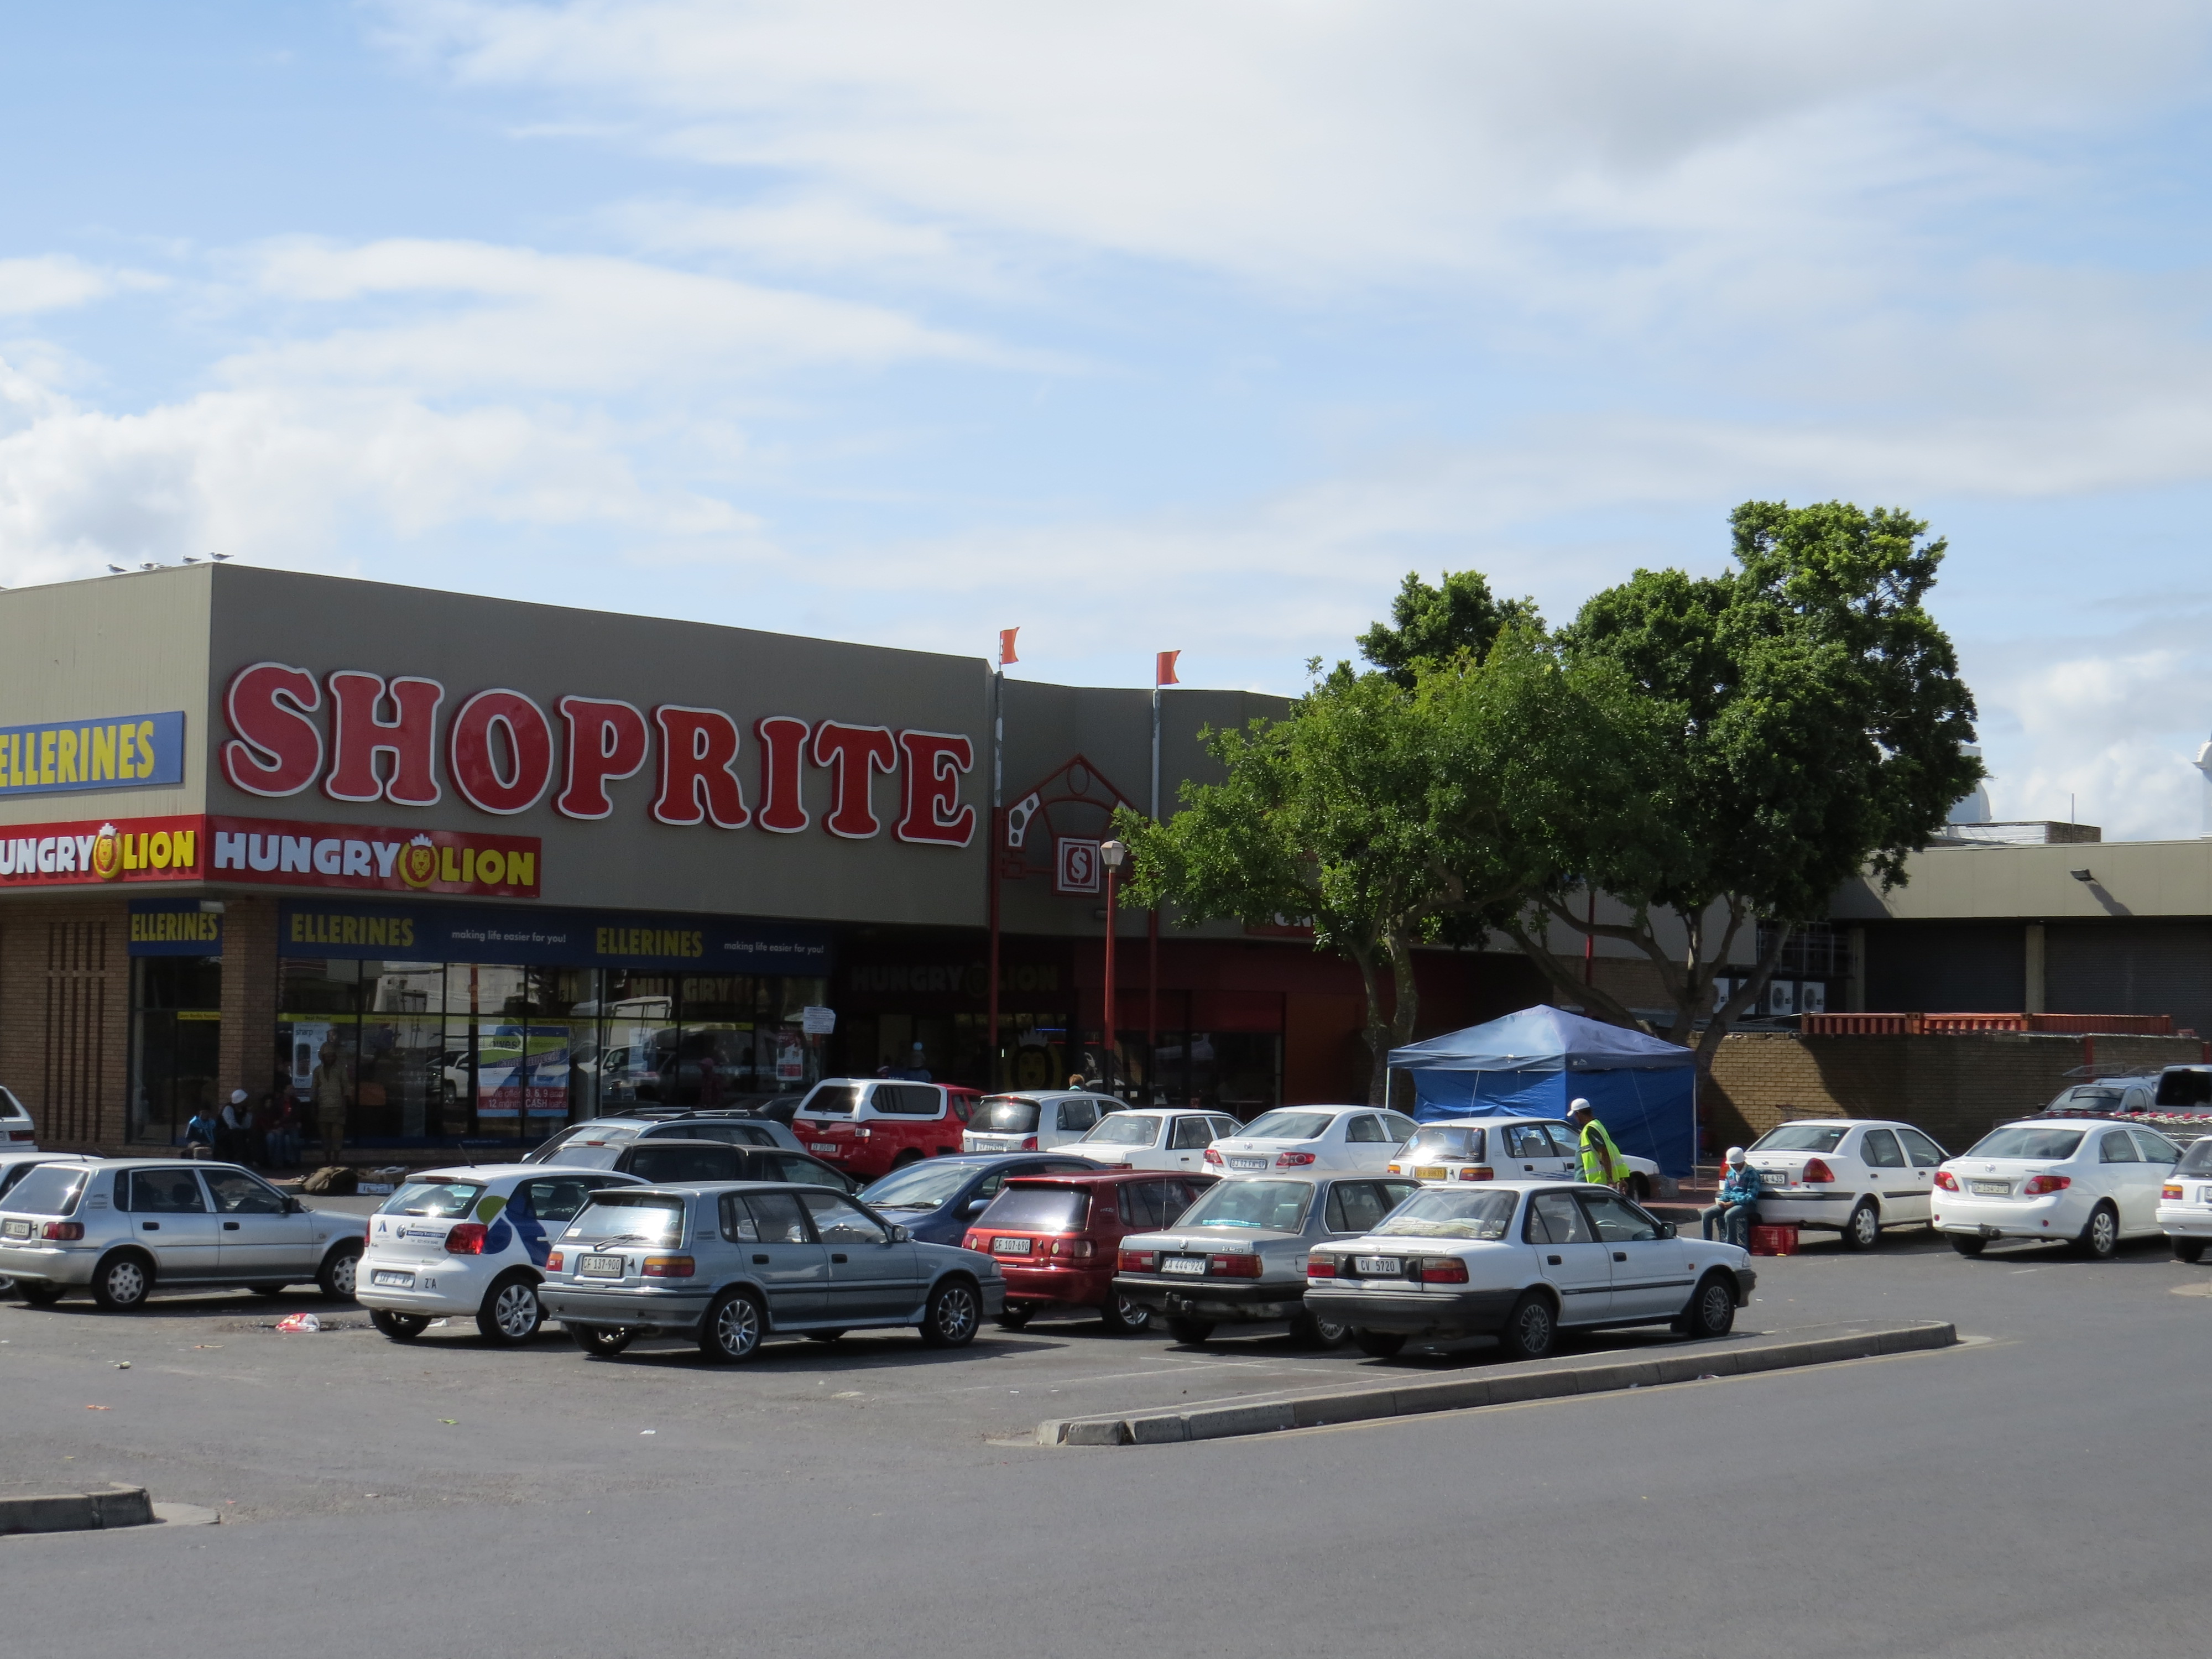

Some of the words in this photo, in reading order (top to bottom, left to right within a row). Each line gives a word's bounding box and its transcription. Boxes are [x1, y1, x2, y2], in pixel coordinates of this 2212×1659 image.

[0, 721, 154, 787] ELLERINES
[224, 662, 976, 848] SHOPRITE
[123, 831, 195, 870] LION
[215, 832, 400, 877] HUNGRY
[440, 847, 535, 885] LION
[131, 913, 218, 941] ELLERINES
[291, 914, 414, 947] ELLERINES
[452, 930, 486, 942] making
[488, 930, 502, 940] life
[504, 932, 530, 941] easier
[532, 932, 545, 942] for
[547, 934, 566, 945] you!
[596, 927, 703, 958] ELLERINES
[724, 941, 754, 953] making
[755, 942, 768, 951] life
[769, 943, 792, 952] easier
[794, 943, 805, 952] for
[807, 945, 824, 956] you!
[851, 965, 964, 992] HUNGRY
[543, 1089, 549, 1097] 9
[549, 1089, 564, 1098] and
[488, 1099, 497, 1108] 12
[525, 1098, 548, 1108] CASH
[549, 1099, 567, 1108] loans
[1761, 1175, 1783, 1183] 14-435
[995, 1239, 1003, 1249] CF
[1004, 1240, 1029, 1251] 107-690
[583, 1258, 592, 1269] CF
[593, 1258, 620, 1270] 137-900
[1164, 1259, 1172, 1269] CA
[1361, 1260, 1370, 1271] CV
[1376, 1260, 1395, 1272] 5720
